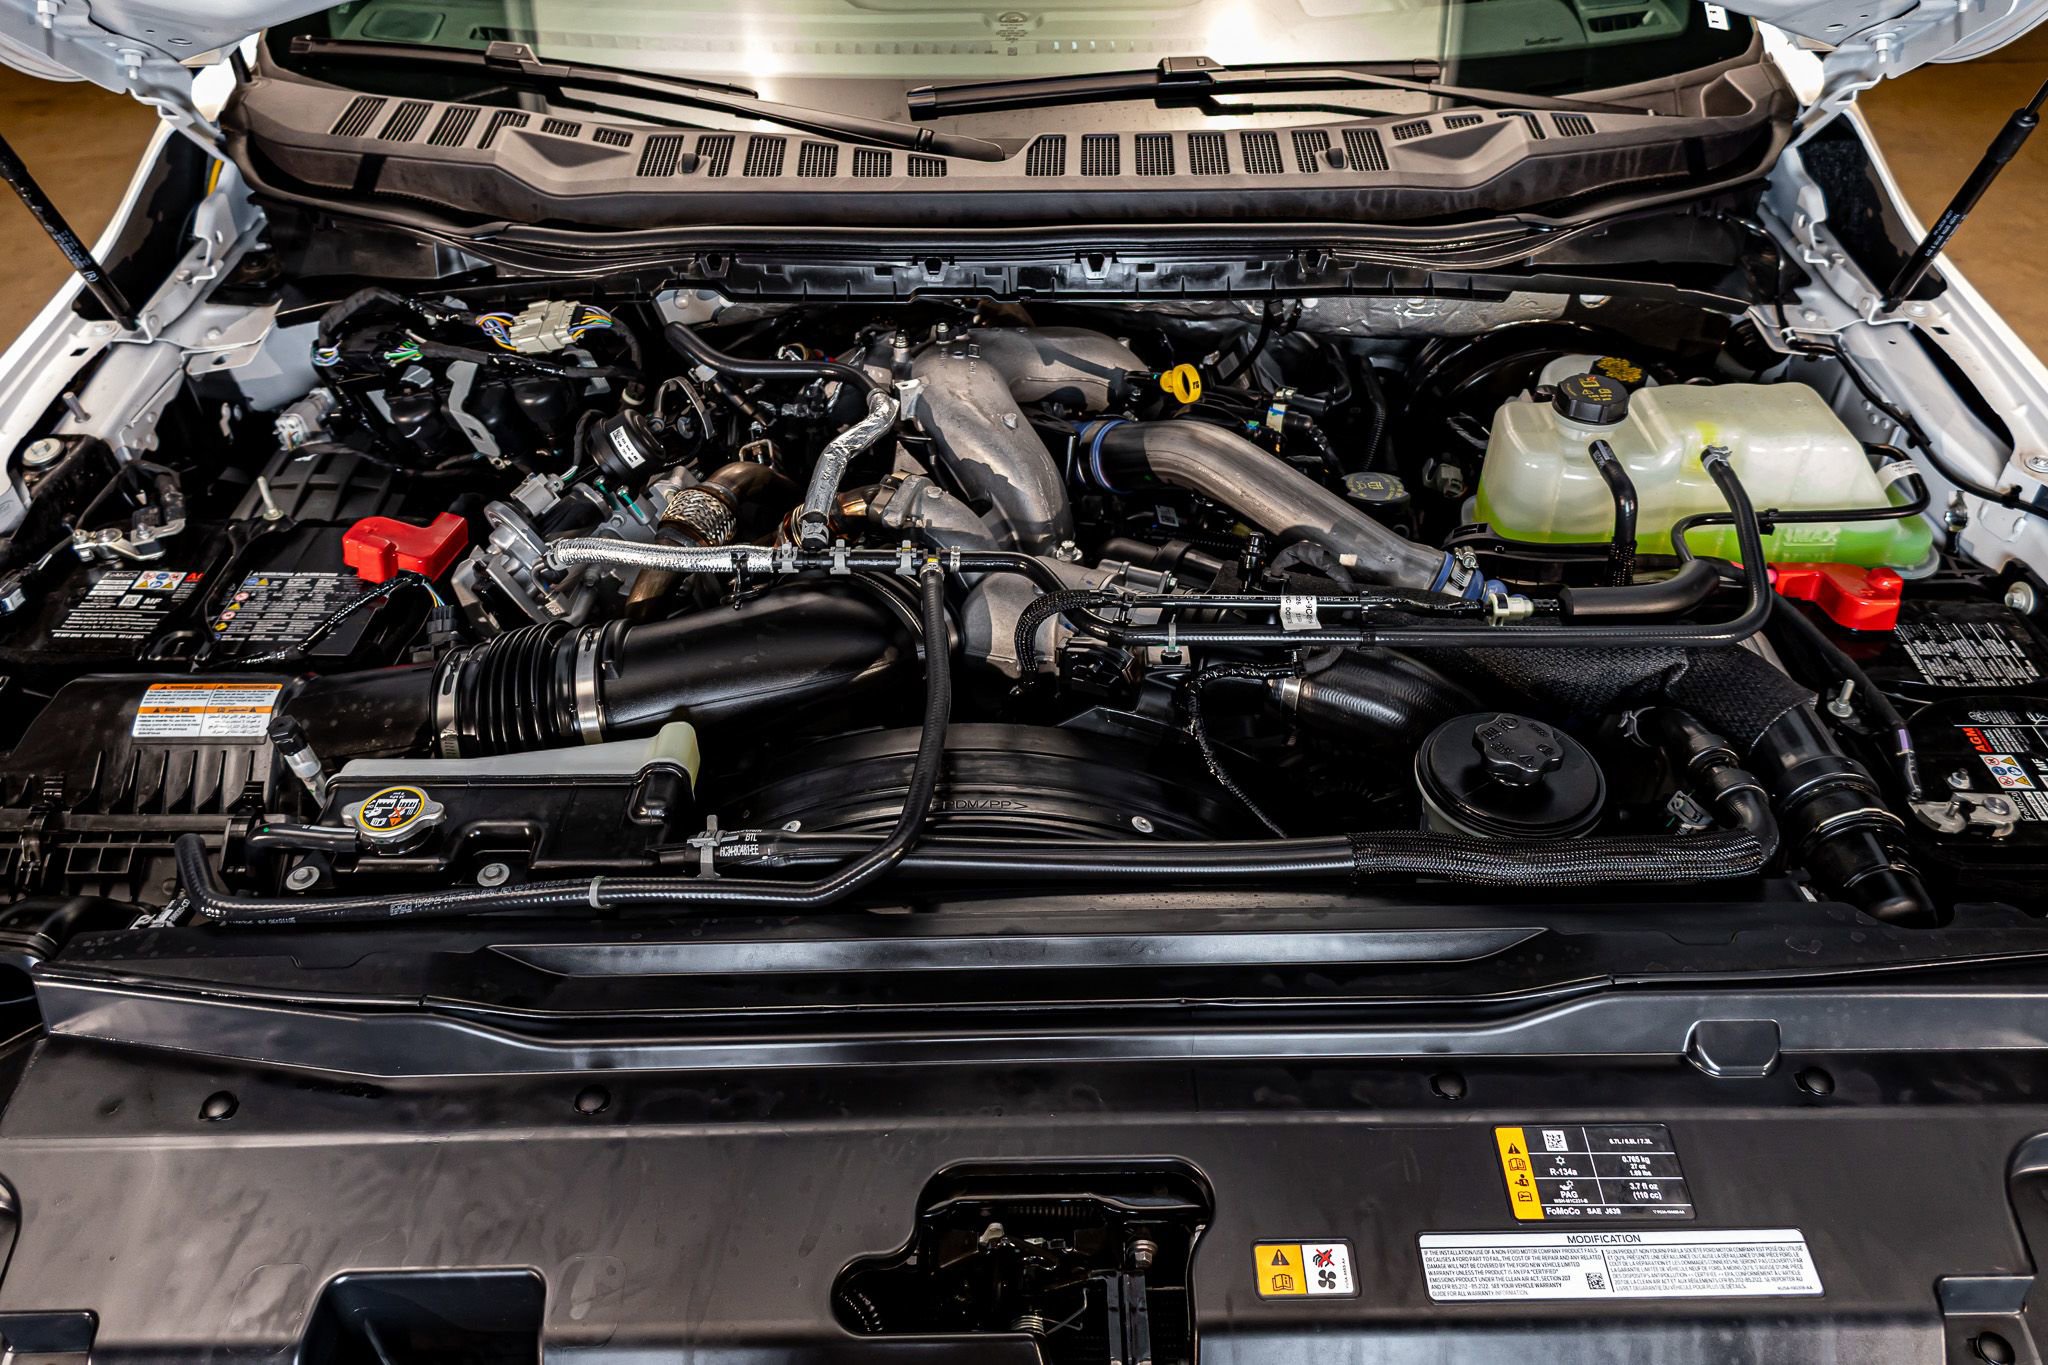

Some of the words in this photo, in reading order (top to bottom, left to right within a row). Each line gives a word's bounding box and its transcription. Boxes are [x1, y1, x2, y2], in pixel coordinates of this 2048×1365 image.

[1962, 727, 1987, 752] AGM
[2011, 792, 2036, 820] FoMoCo
[1641, 1156, 1650, 1164] kg
[1633, 1192, 1648, 1200] (110
[1650, 1192, 1662, 1200] cc)
[1567, 1234, 1642, 1244] MODIFICATION
